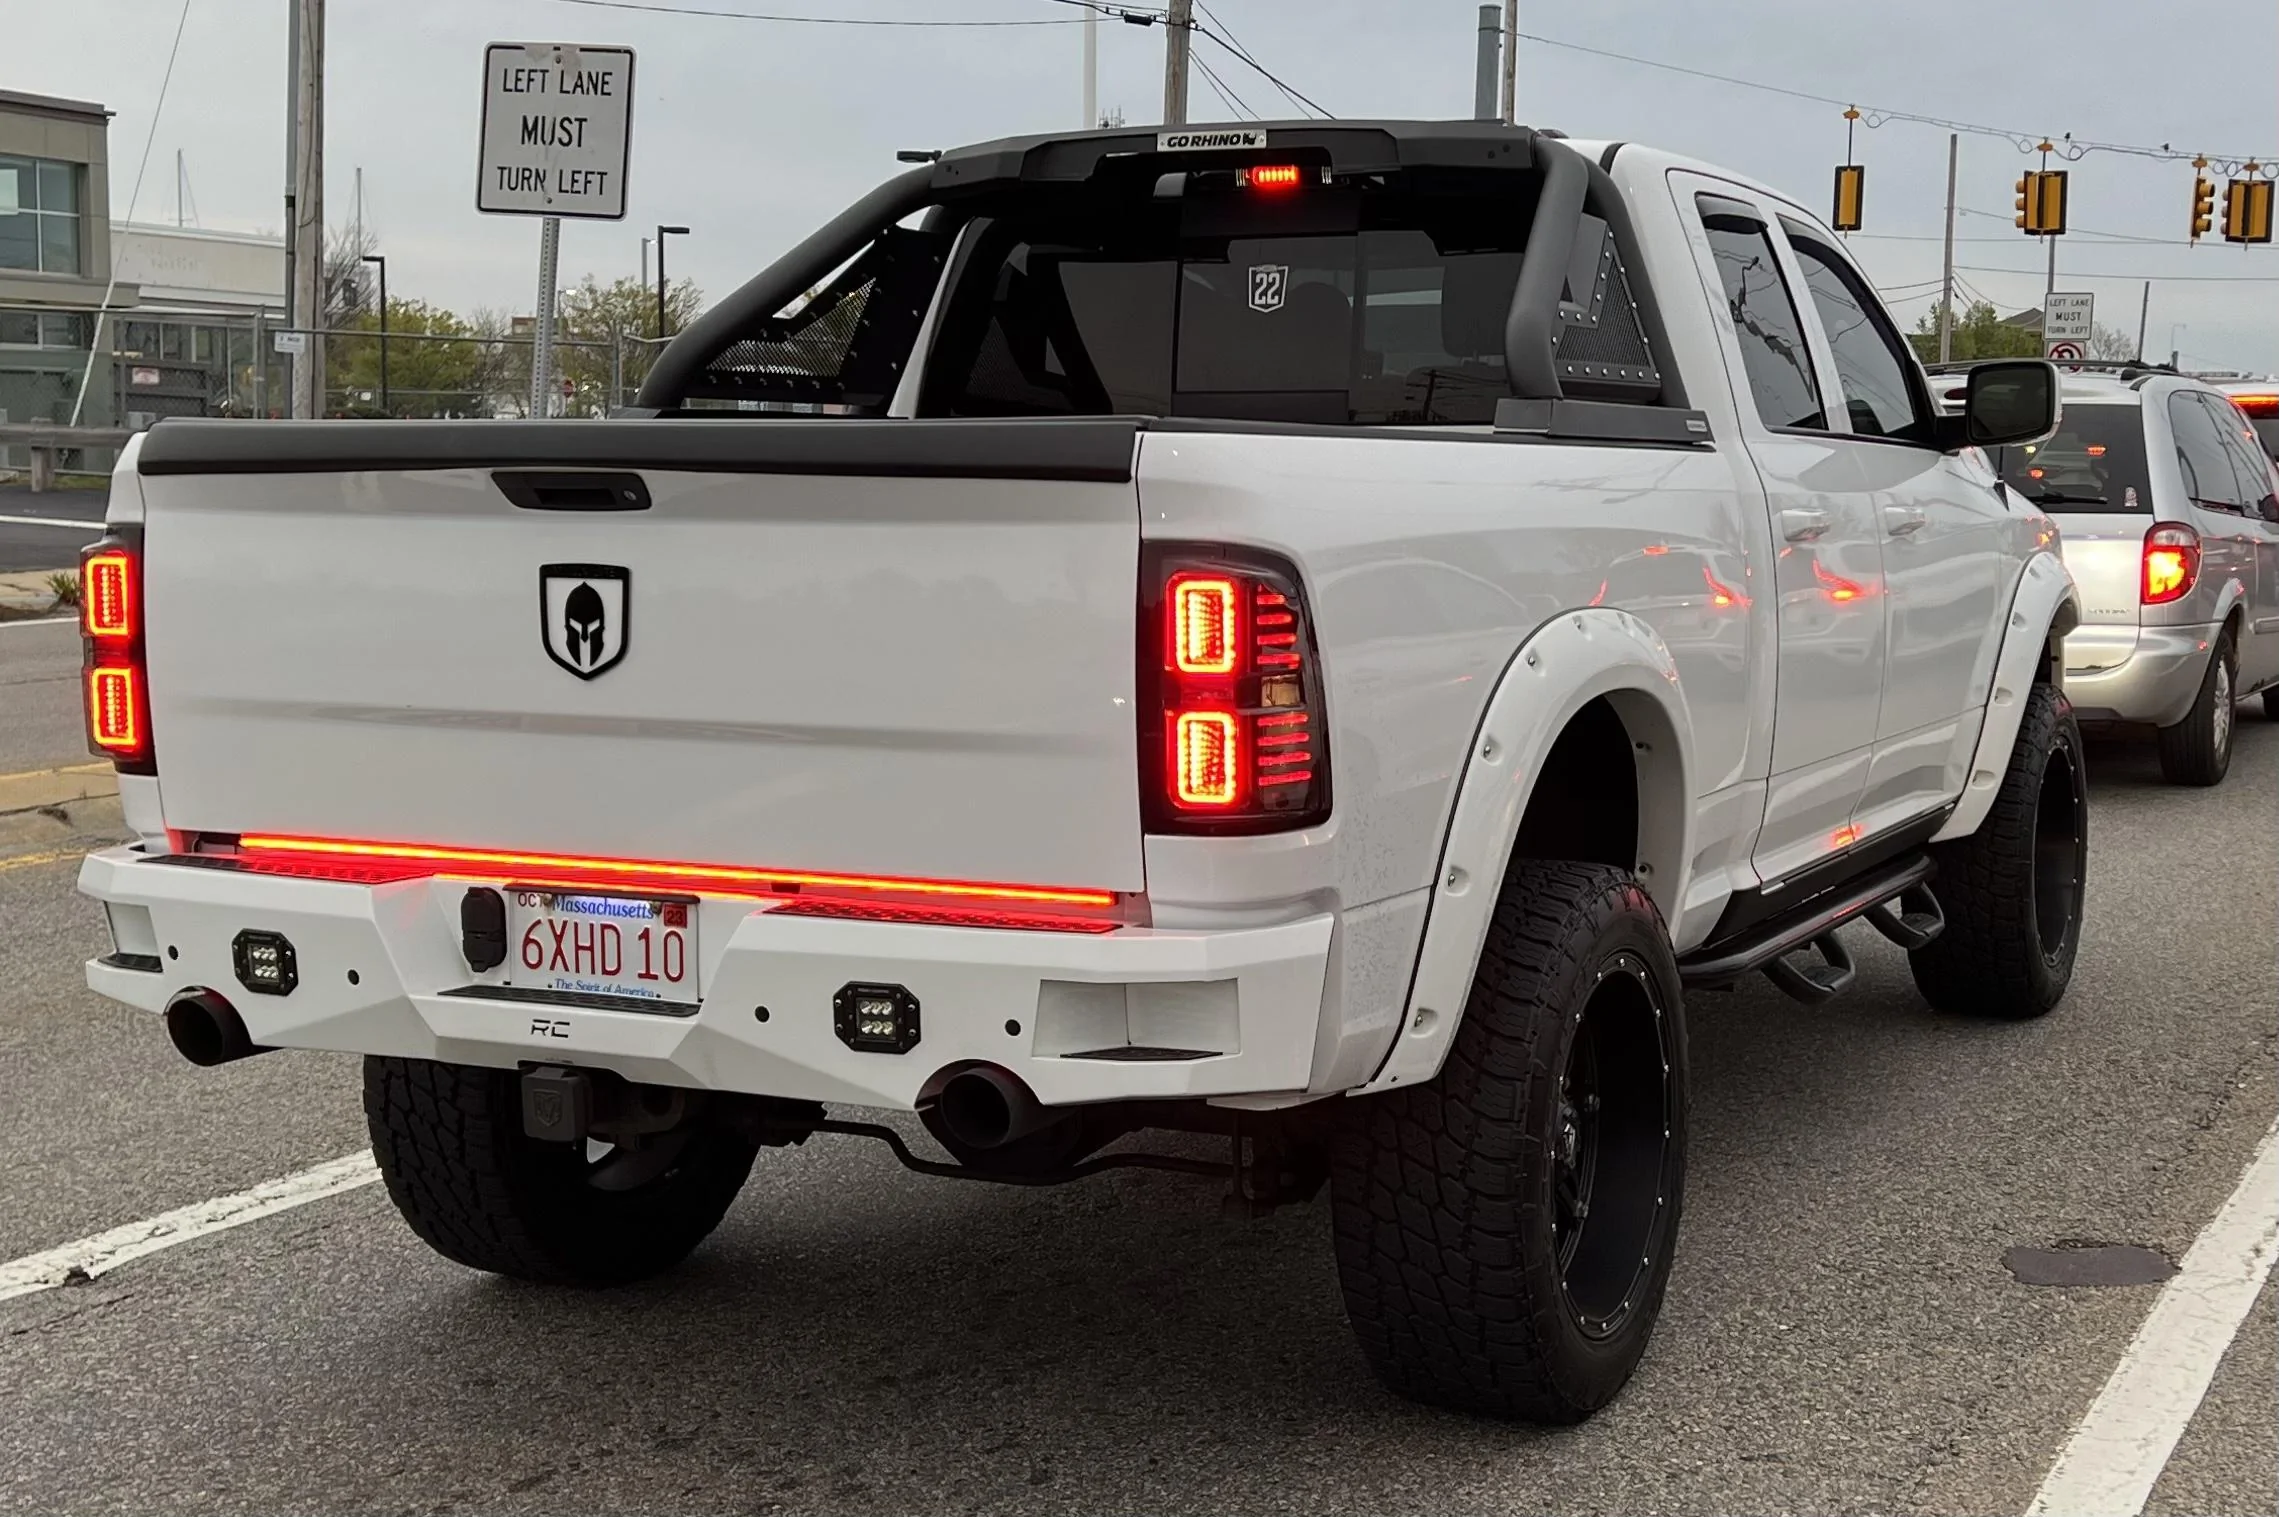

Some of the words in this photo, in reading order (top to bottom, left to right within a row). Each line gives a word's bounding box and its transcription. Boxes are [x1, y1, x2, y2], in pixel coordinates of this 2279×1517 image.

[502, 68, 550, 93] LEFT
[559, 70, 613, 96] LANE
[520, 115, 588, 148] MUST
[496, 166, 547, 192] TURN
[558, 169, 608, 196] LEFT
[1254, 272, 1280, 305] 22
[2049, 298, 2067, 307] LEFT
[2071, 298, 2090, 307] LANE
[2056, 312, 2081, 321] MUST
[2047, 326, 2066, 334] TURN
[2071, 326, 2088, 334] LEFT
[552, 894, 655, 920] Massachusetts
[666, 909, 684, 926] 23
[521, 918, 622, 976] 6XHD
[637, 926, 685, 983] 10
[555, 978, 573, 990] The
[603, 983, 613, 992] of
[530, 1018, 571, 1039] RC
